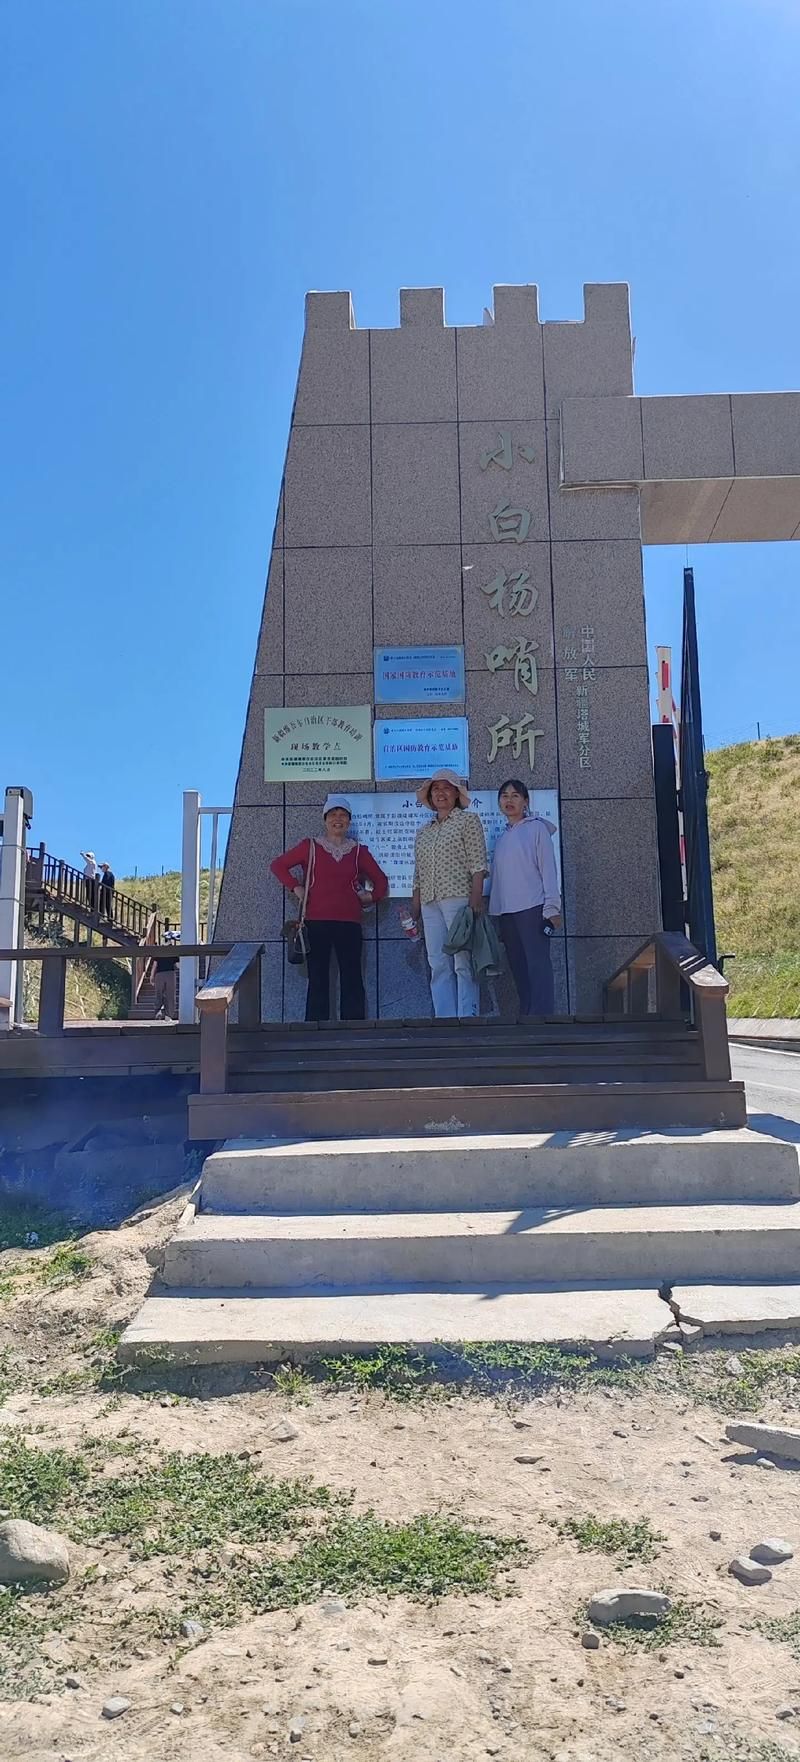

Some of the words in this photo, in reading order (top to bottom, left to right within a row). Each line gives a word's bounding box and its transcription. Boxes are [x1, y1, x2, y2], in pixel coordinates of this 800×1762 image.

[480, 431, 545, 771] 小白杨哨所
[581, 625, 597, 682] 中国人民
[290, 742, 342, 751] 现场教学点
